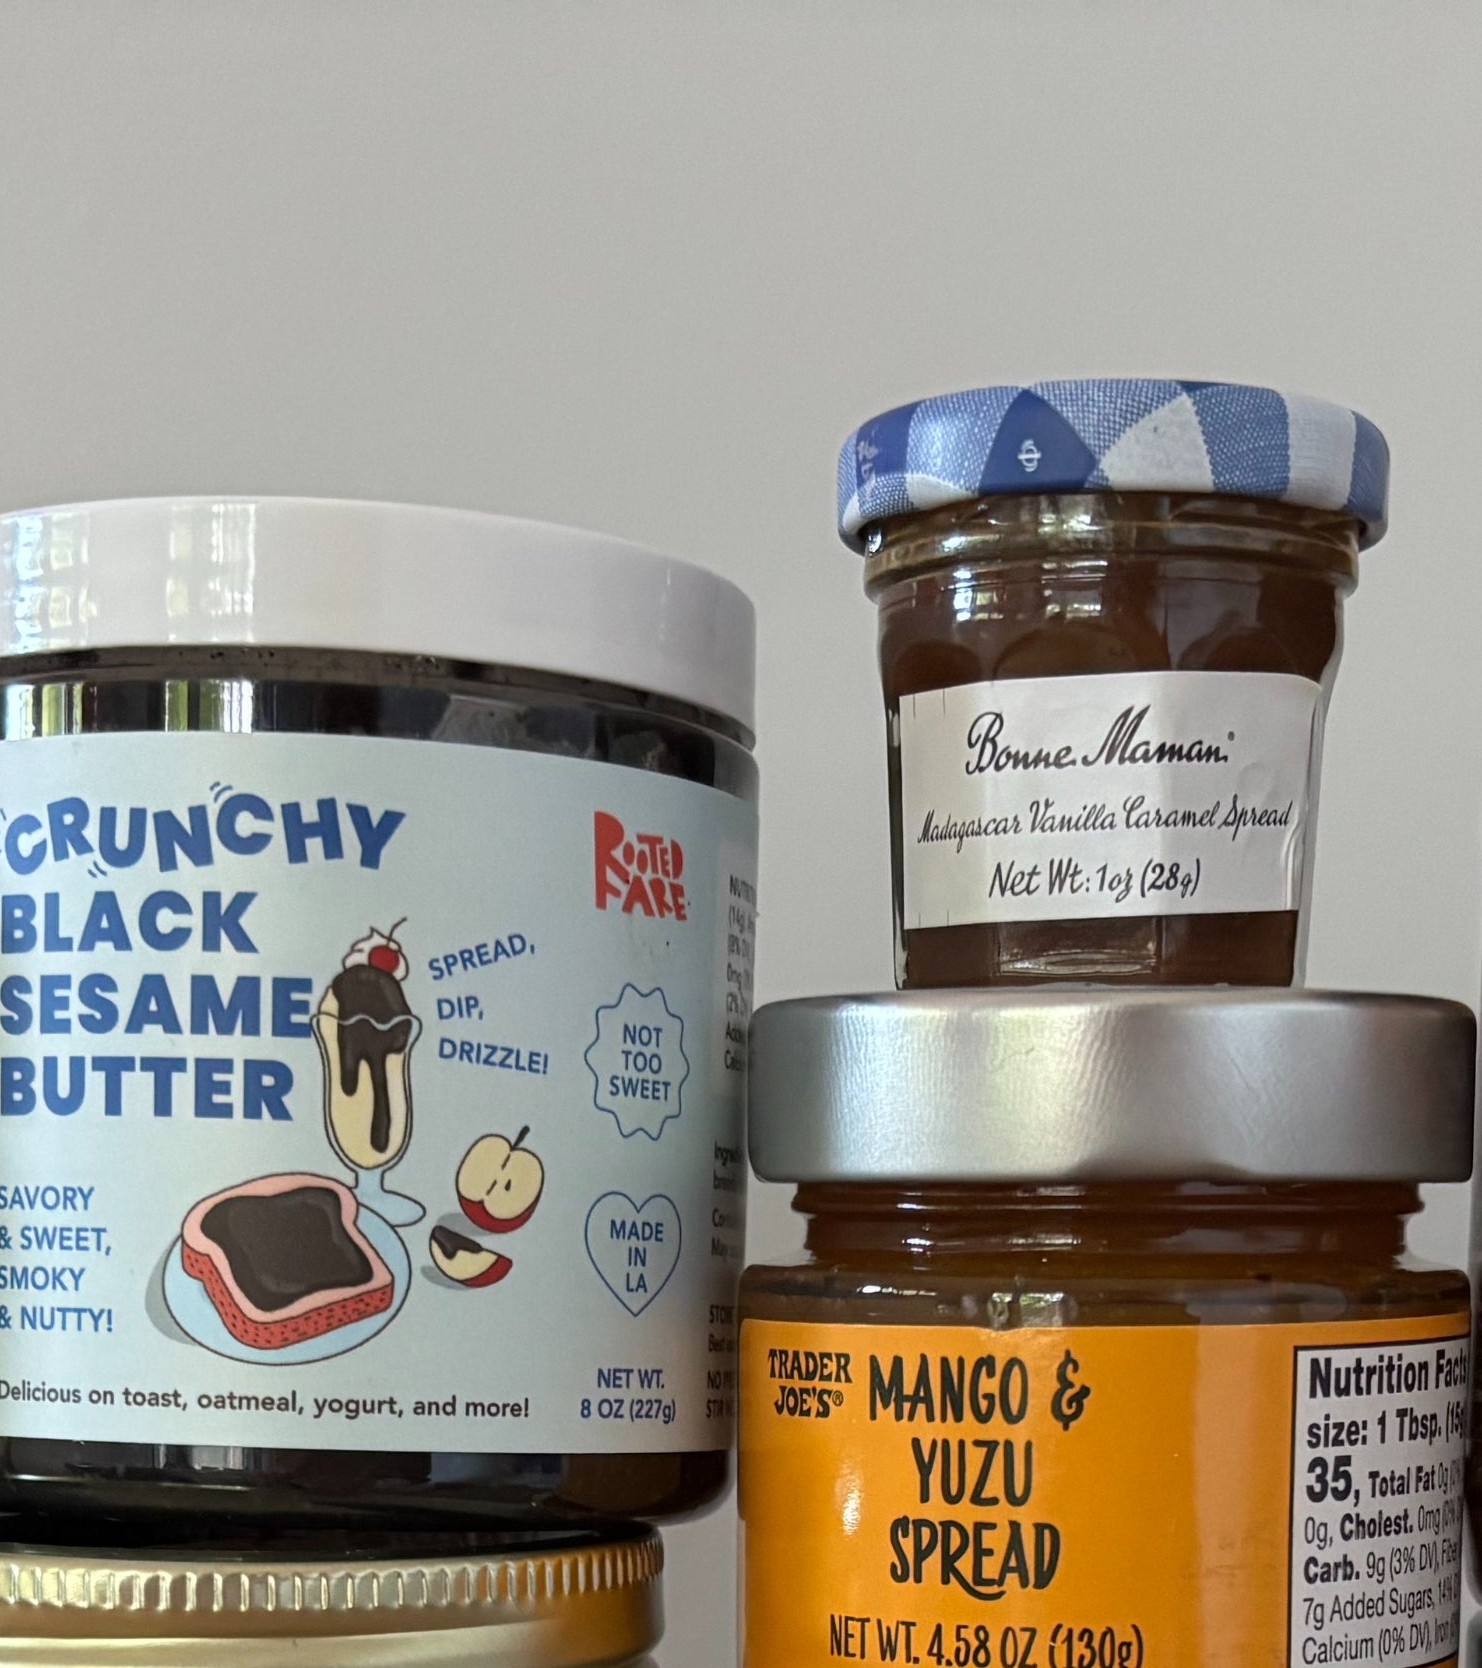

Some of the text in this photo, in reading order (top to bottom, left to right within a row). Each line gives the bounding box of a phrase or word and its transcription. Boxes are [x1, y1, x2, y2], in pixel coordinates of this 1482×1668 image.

[966, 705, 1229, 775] Bonne Maman
[4, 793, 406, 875] CRUNCHY
[918, 794, 1293, 853] Madagascar Vanilla Caramel Spread
[1, 891, 259, 954] BLACK
[428, 934, 536, 980] SPREAD,
[0, 973, 313, 1038] SESAME
[437, 996, 484, 1020] DIP,
[623, 1024, 663, 1047] NOT
[438, 1038, 549, 1074] DRIZZLE!
[622, 1051, 662, 1074] TOO
[1, 1056, 294, 1121] BUTTER
[609, 1075, 671, 1101] SWEET
[19, 1226, 111, 1255] SWEET,
[610, 1220, 663, 1241] MADE
[628, 1247, 647, 1267] IN
[626, 1273, 647, 1293] LA
[20, 1307, 113, 1332] NUTTY!
[596, 1367, 665, 1390] NET WT.
[768, 1348, 852, 1383] TRADER
[1309, 1353, 1430, 1399] Nutrition
[1435, 1349, 1467, 1389] Facts
[89, 1388, 115, 1405] on
[122, 1386, 188, 1411] toast,
[197, 1390, 304, 1415] oatmeal,
[313, 1396, 404, 1421] yogurt,
[413, 1395, 457, 1418] and
[465, 1397, 530, 1418] more!
[869, 1349, 1091, 1431] MANGO &
[580, 1399, 677, 1424] 8 OZ (227g)
[1307, 1413, 1367, 1449] size:
[1377, 1410, 1386, 1444] 1
[1396, 1407, 1442, 1446] Tbsp.
[911, 1438, 1033, 1507] YUZU
[1304, 1516, 1333, 1550] 0g,
[1340, 1508, 1413, 1541] Cholest.
[1418, 1505, 1440, 1535] 0mg
[890, 1516, 1061, 1600] SPREAD
[829, 1615, 870, 1659] NET
[877, 1619, 920, 1664] WT.
[927, 1623, 991, 1668] 4.58
